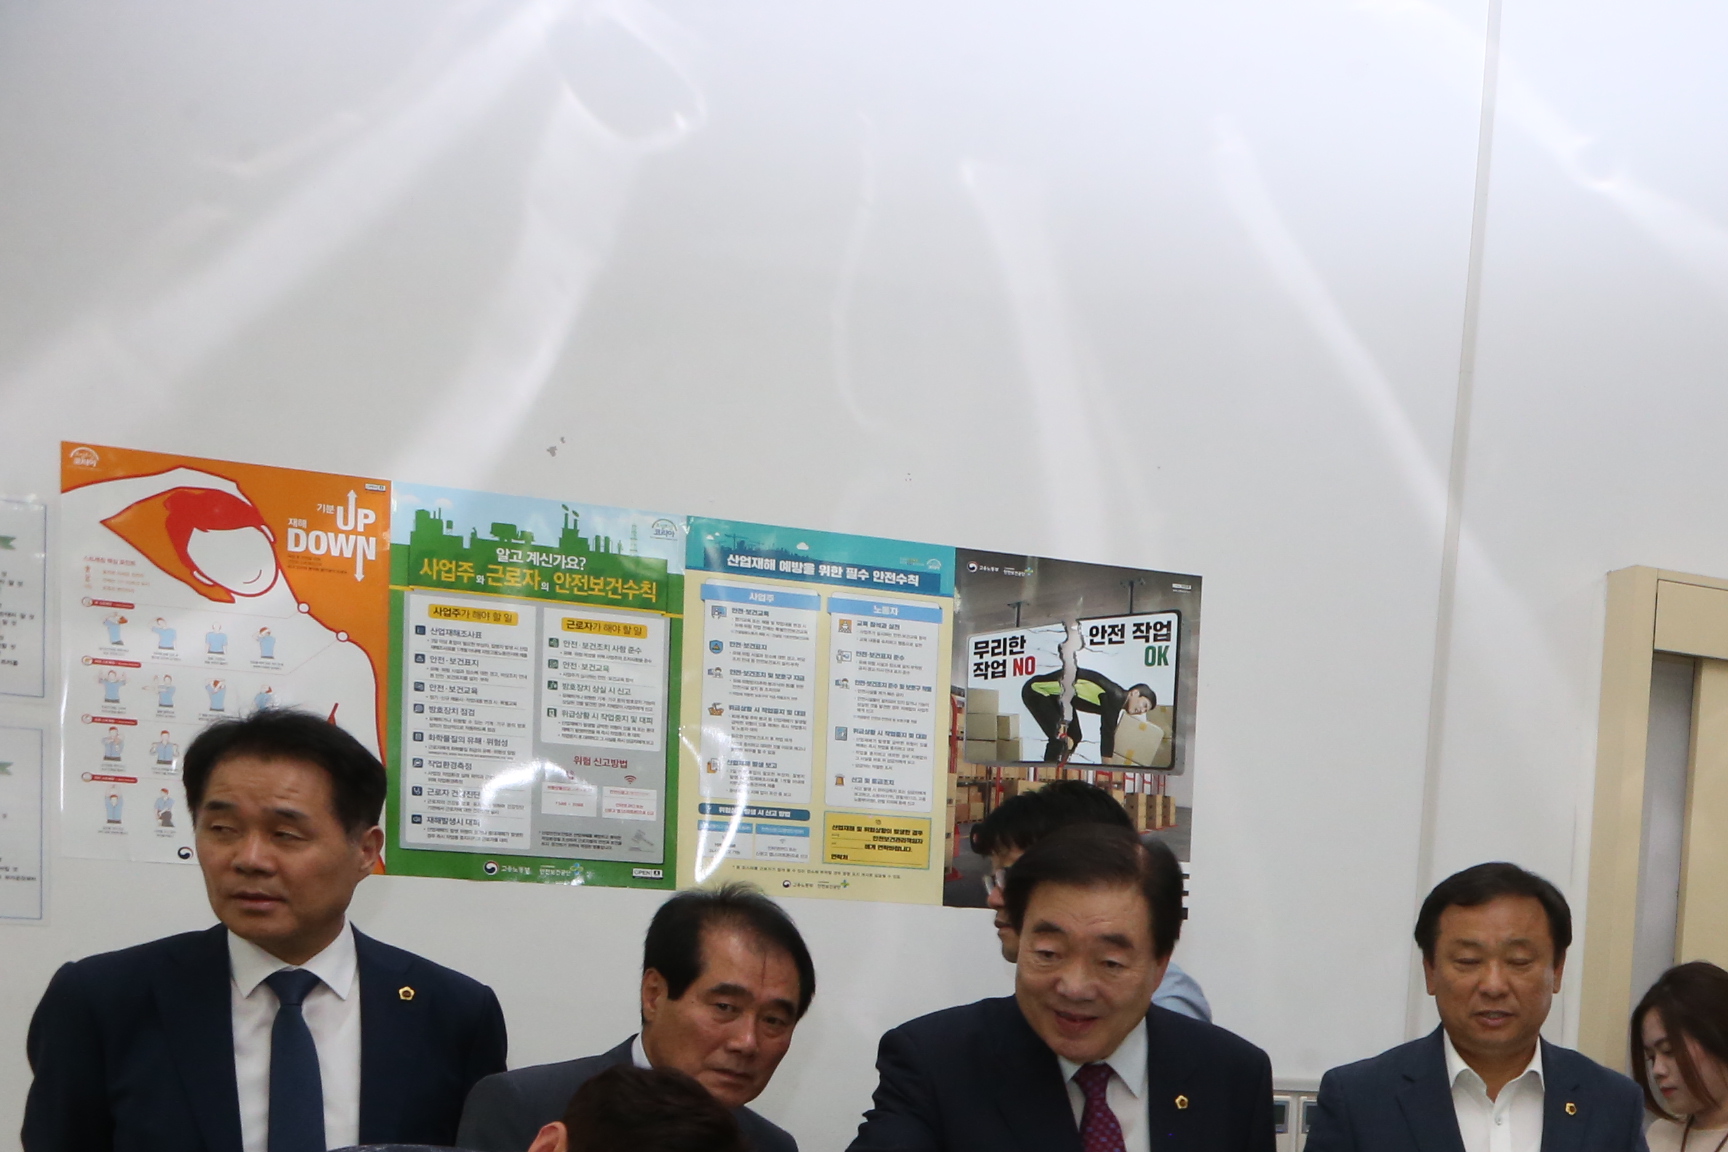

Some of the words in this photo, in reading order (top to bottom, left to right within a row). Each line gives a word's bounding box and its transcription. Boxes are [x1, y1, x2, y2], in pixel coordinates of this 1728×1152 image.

[288, 518, 307, 528] 재해
[317, 504, 335, 514] 기분
[336, 505, 376, 532] UP
[287, 527, 376, 561] DOWN
[496, 547, 524, 563] 알고
[527, 550, 587, 570] 계신가요?
[727, 554, 776, 571] 산업재해
[779, 560, 815, 576] 예방을
[819, 564, 843, 578] 위한
[846, 567, 869, 581] 필수
[873, 570, 919, 587] 안전수칙
[553, 572, 658, 603] 안전보건수칙
[433, 606, 470, 618] 사업주가
[472, 611, 490, 620] 해야
[504, 614, 512, 622] 일
[430, 628, 482, 639] 산업재해조사표
[566, 620, 601, 632] 근로자가
[603, 624, 621, 633] 해야
[623, 626, 631, 634] 할
[634, 627, 642, 636] 일
[1089, 623, 1125, 646] 안전
[1132, 620, 1172, 644] 작업
[628, 646, 642, 654] 준수
[973, 635, 1026, 660] 무리한
[1144, 645, 1170, 667] OK
[973, 659, 1007, 680] 작업
[1013, 655, 1036, 677] NO
[617, 687, 631, 695] 신고
[461, 708, 475, 716] 점검
[574, 756, 591, 766] 위험
[594, 757, 627, 769] 신고방법
[427, 788, 449, 796] 근로자
